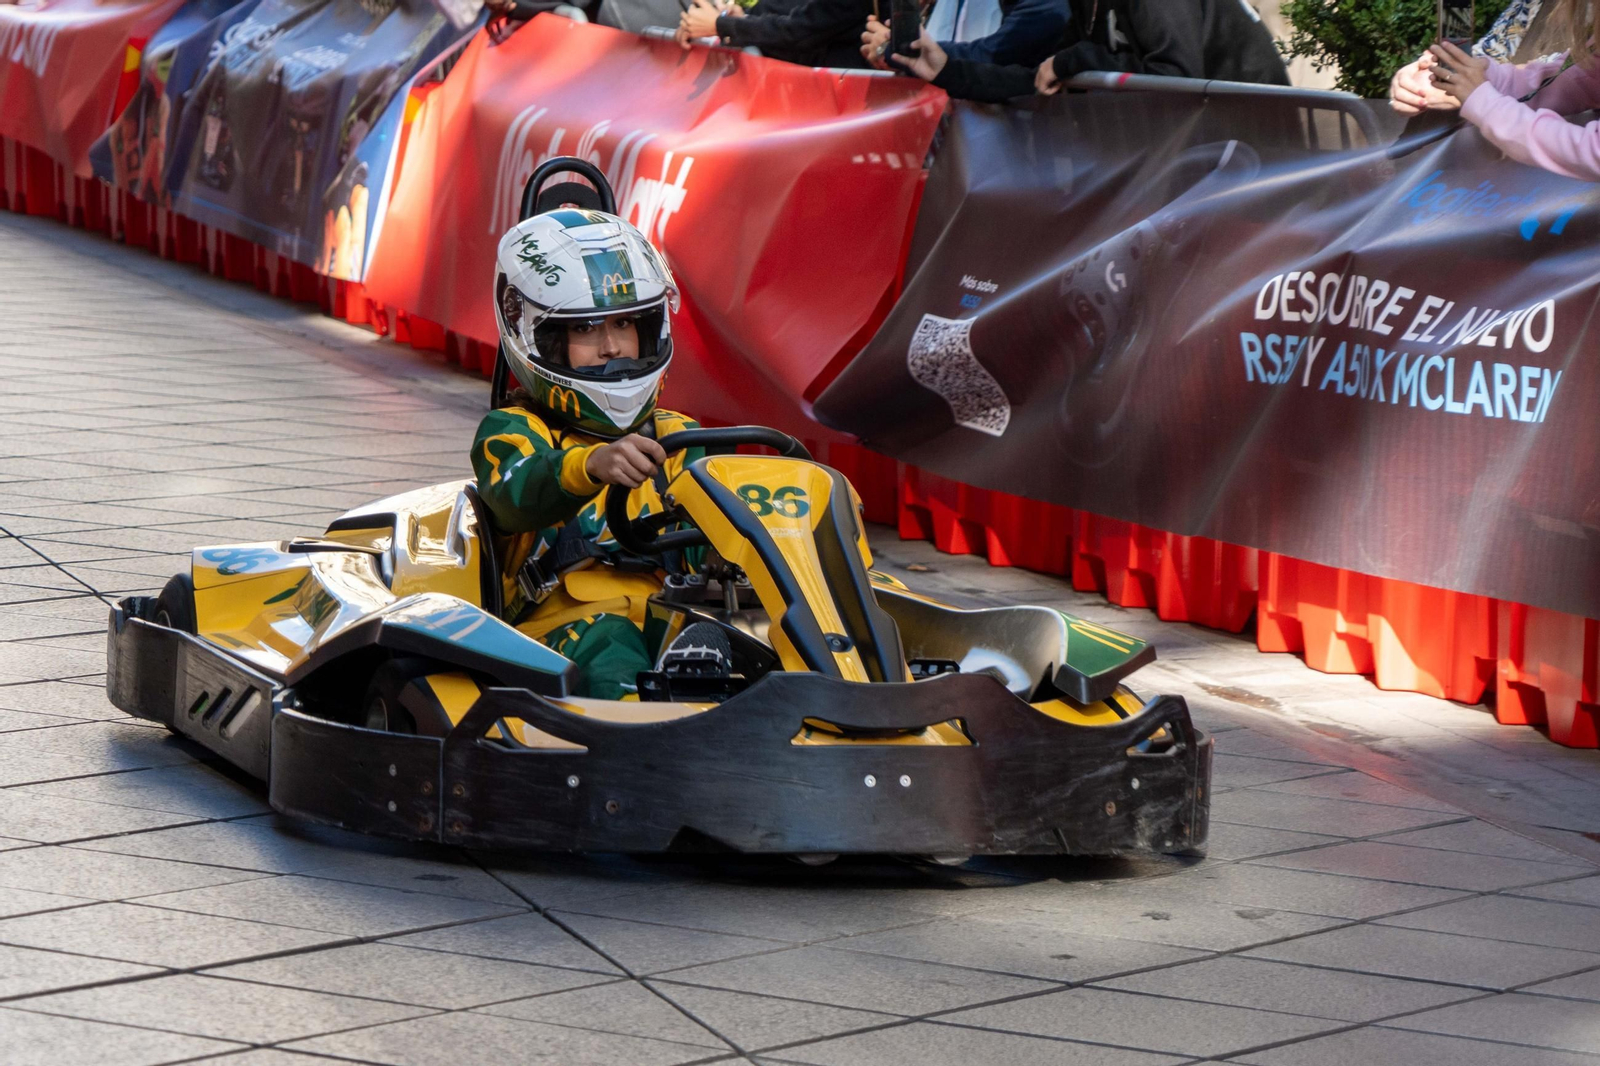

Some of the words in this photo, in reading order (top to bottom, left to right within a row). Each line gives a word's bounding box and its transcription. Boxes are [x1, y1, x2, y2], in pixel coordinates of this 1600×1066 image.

[1254, 271, 1416, 335] DESCUBRE
[1400, 294, 1456, 344] EL
[1436, 298, 1555, 353] NUEVO
[1301, 335, 1327, 388] Y
[1318, 340, 1370, 399] A50
[1369, 347, 1398, 402] X
[1390, 352, 1563, 423] MCLAREN
[736, 483, 810, 519] 86
